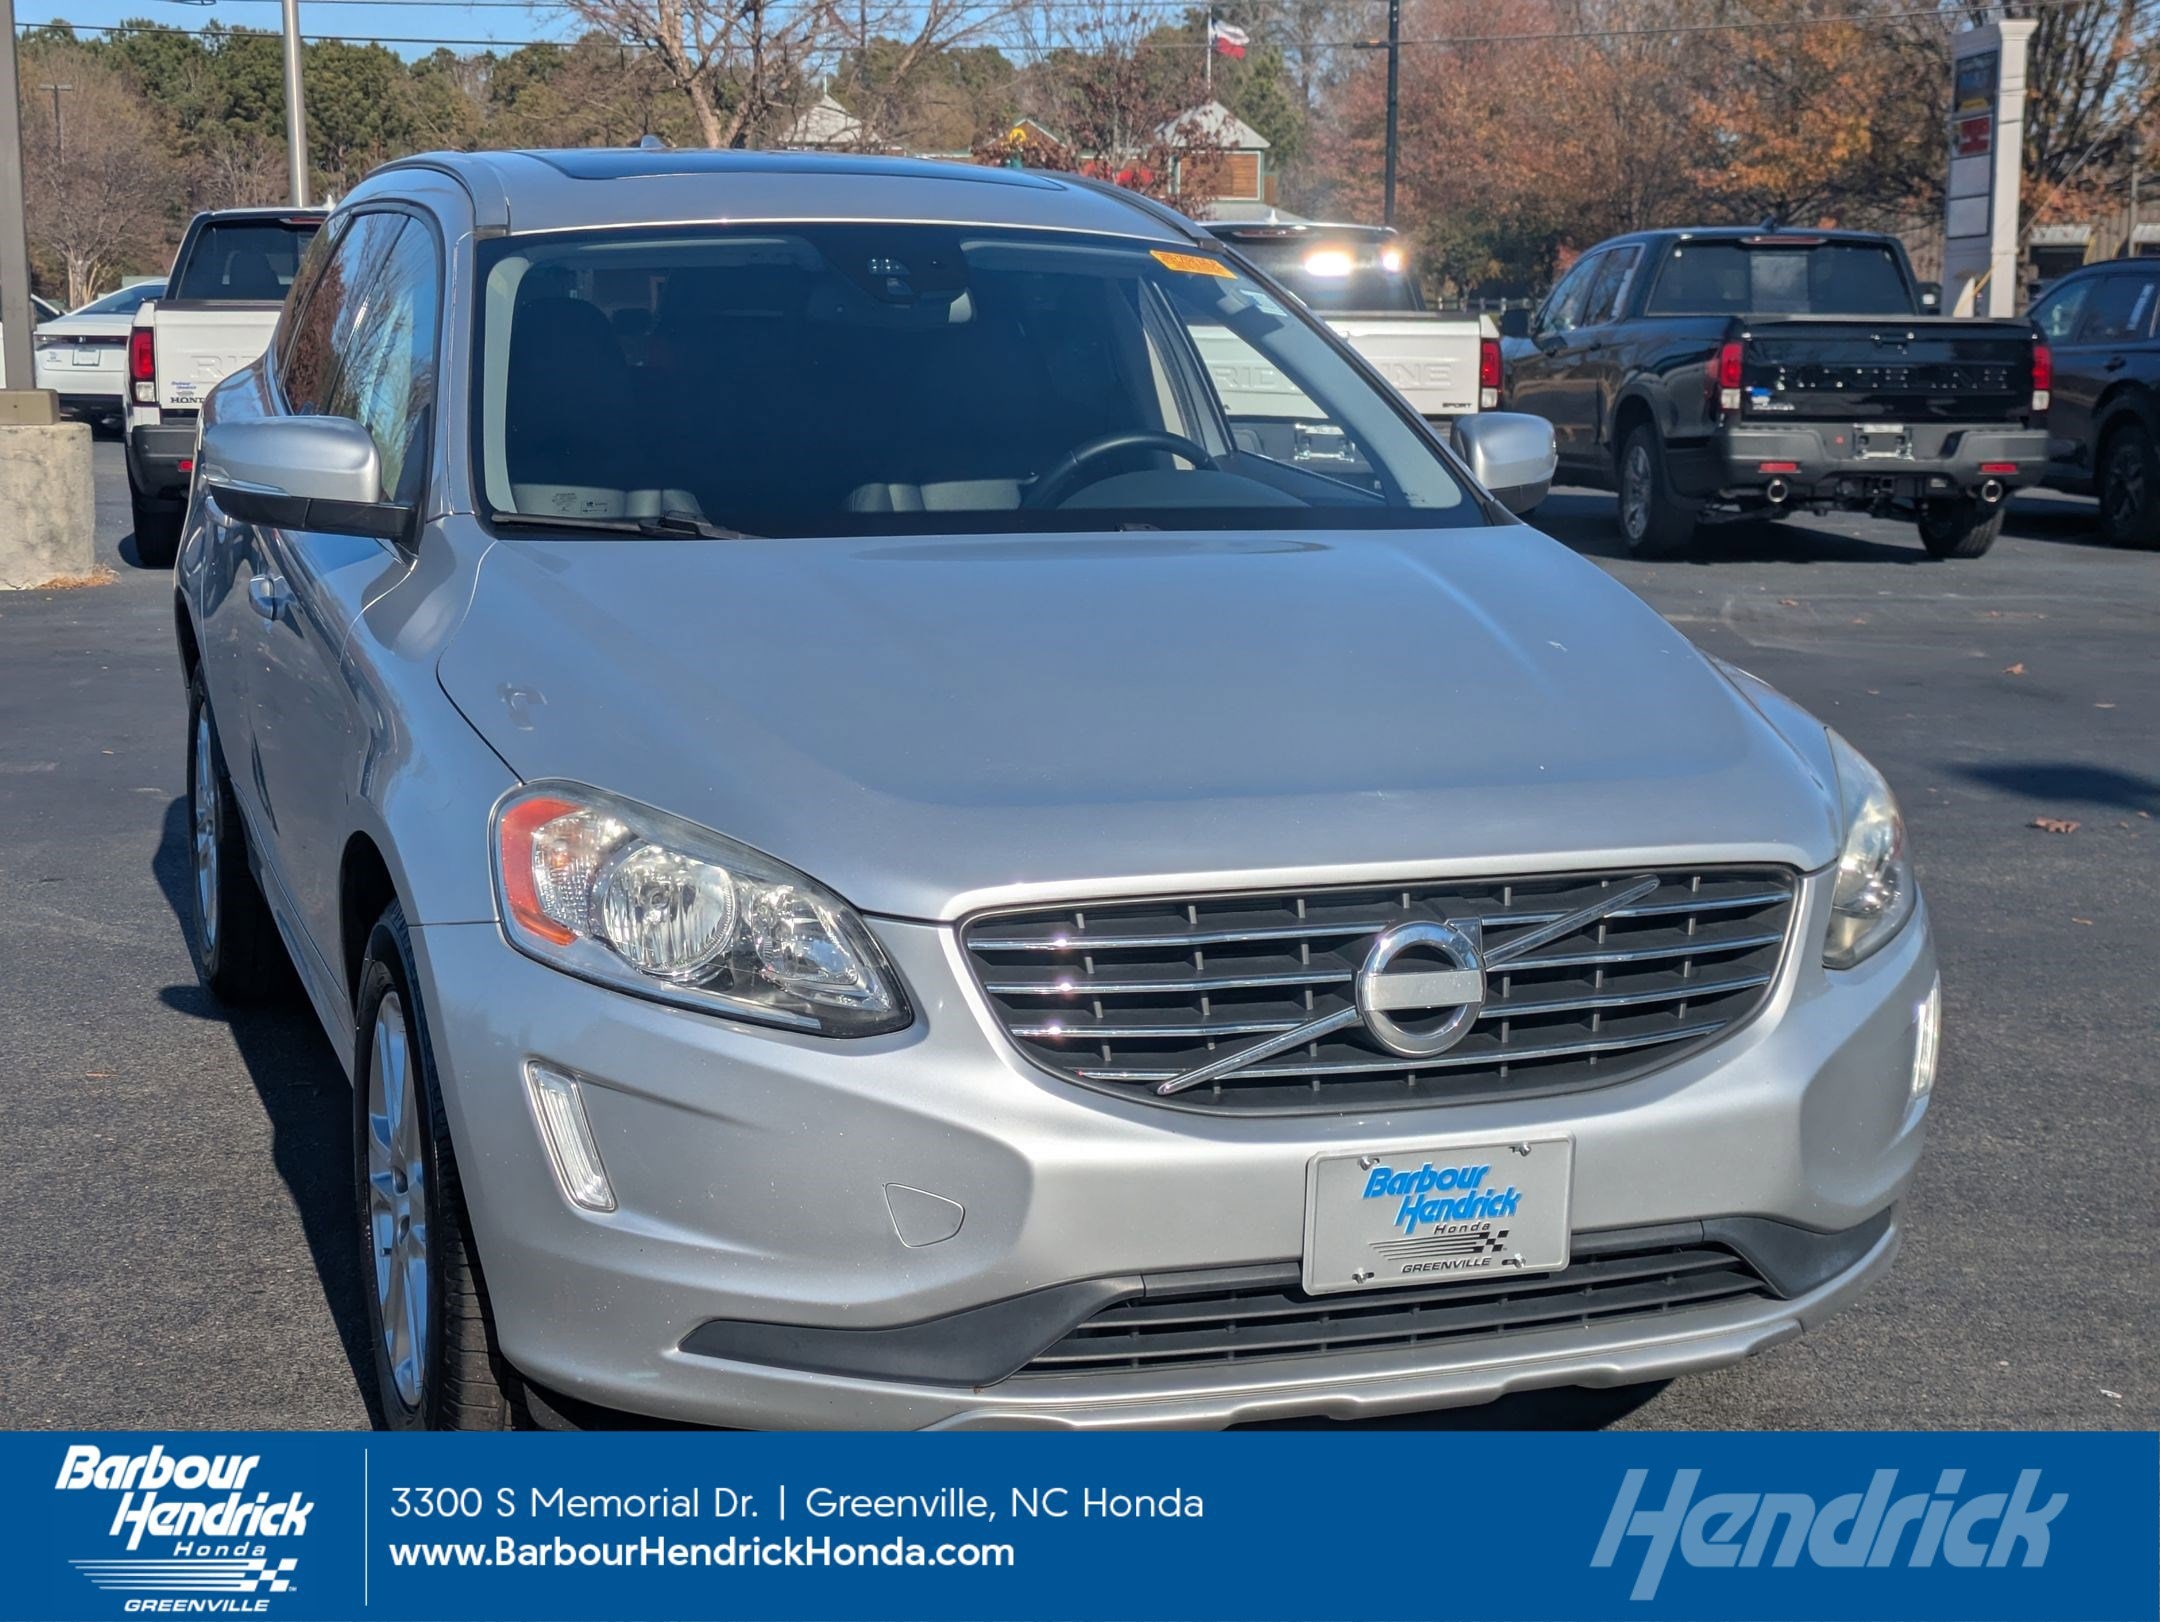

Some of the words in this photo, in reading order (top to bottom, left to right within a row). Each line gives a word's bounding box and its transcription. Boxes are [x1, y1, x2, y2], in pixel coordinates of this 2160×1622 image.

[1362, 1162, 1491, 1199] Barbour
[1393, 1184, 1523, 1235] Hendrick
[1433, 1221, 1490, 1235] Honda
[1401, 1257, 1492, 1274] GREENVILLE
